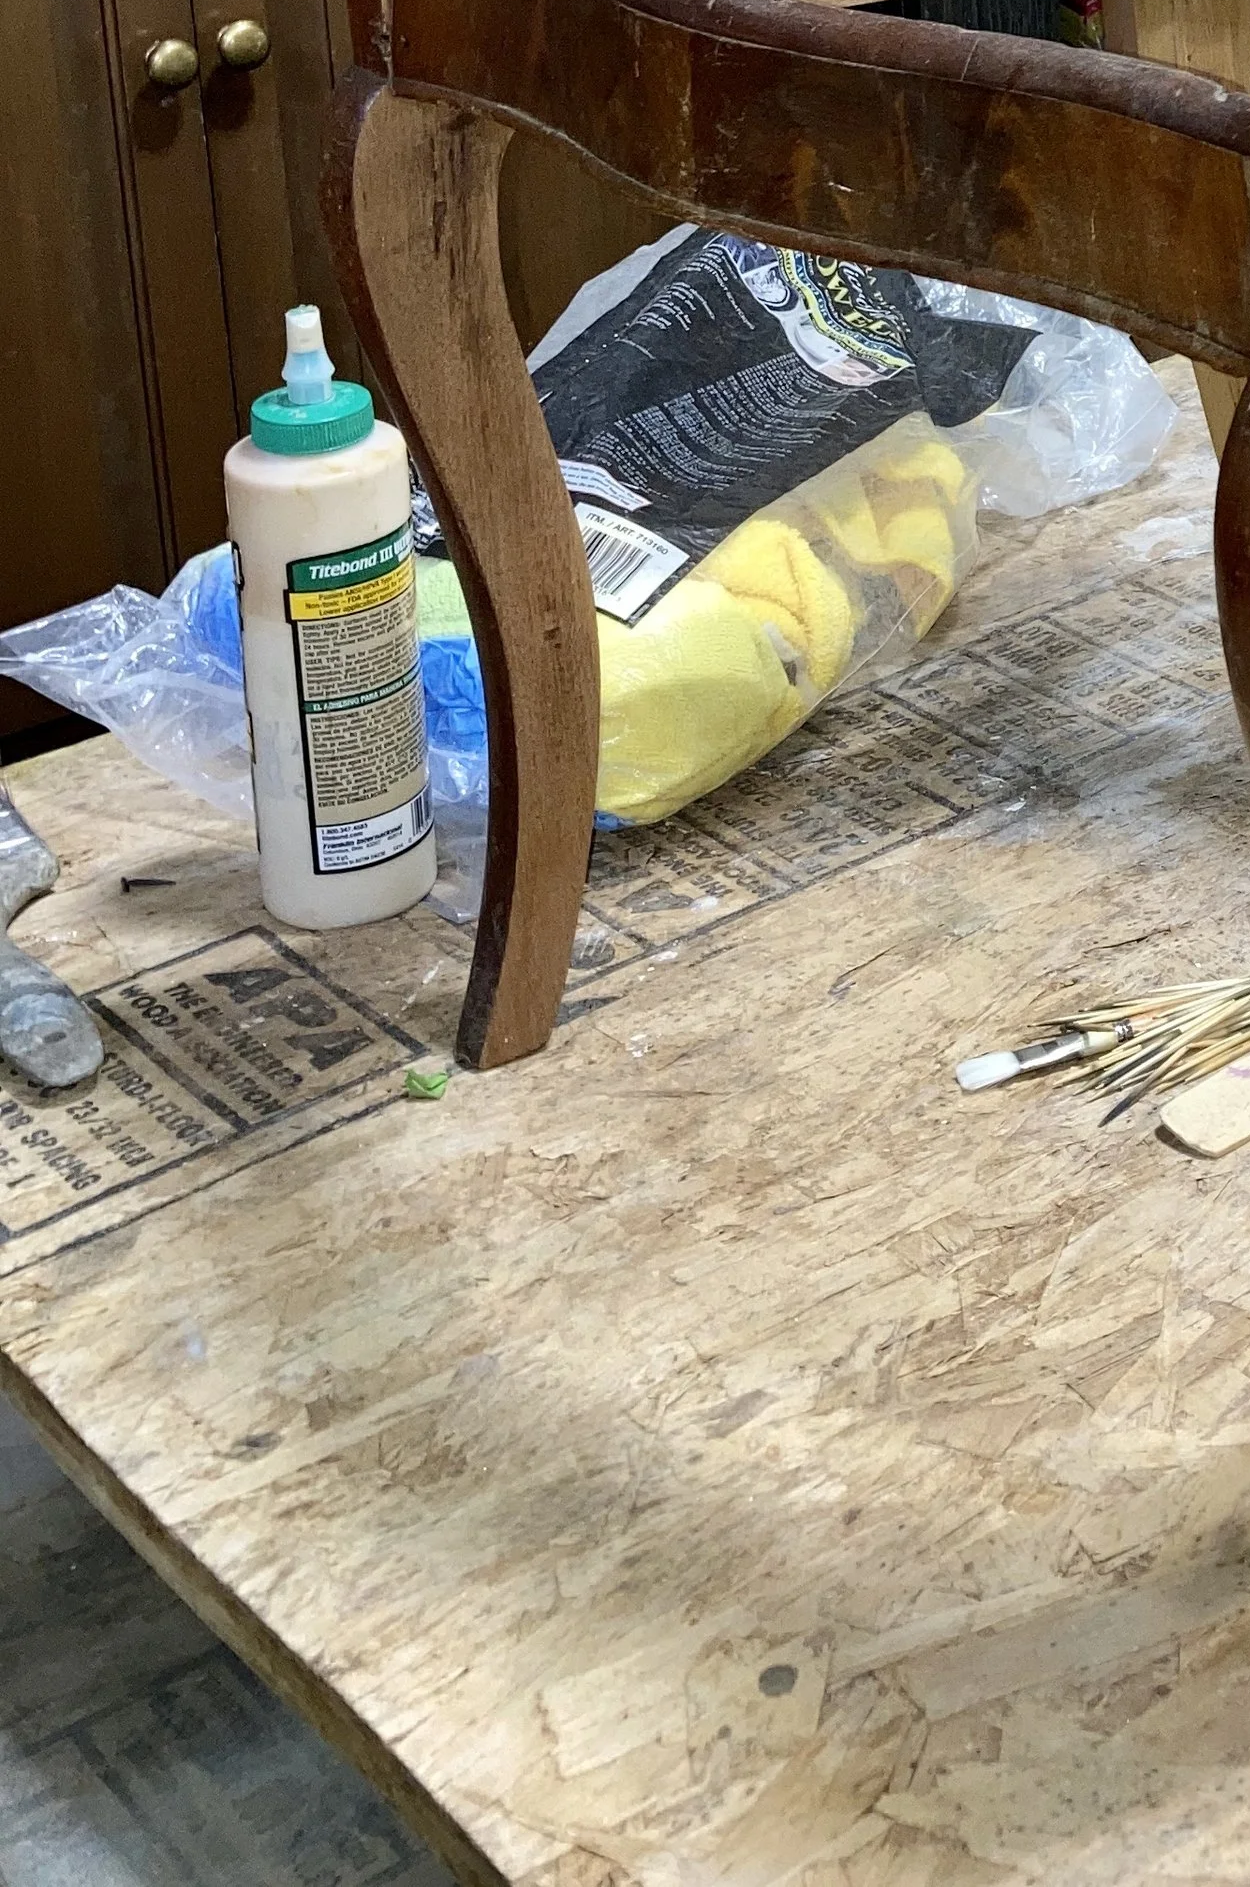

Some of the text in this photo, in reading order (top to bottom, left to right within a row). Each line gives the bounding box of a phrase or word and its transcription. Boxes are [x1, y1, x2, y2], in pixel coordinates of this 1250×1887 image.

[585, 512, 605, 526] ITM.
[613, 524, 635, 537] ART.
[309, 545, 393, 580] Titebond III
[118, 984, 180, 1029] WOOD
[203, 966, 376, 1072] APA
[20, 1128, 103, 1192] SPACING
[105, 1137, 156, 1169] INCH
